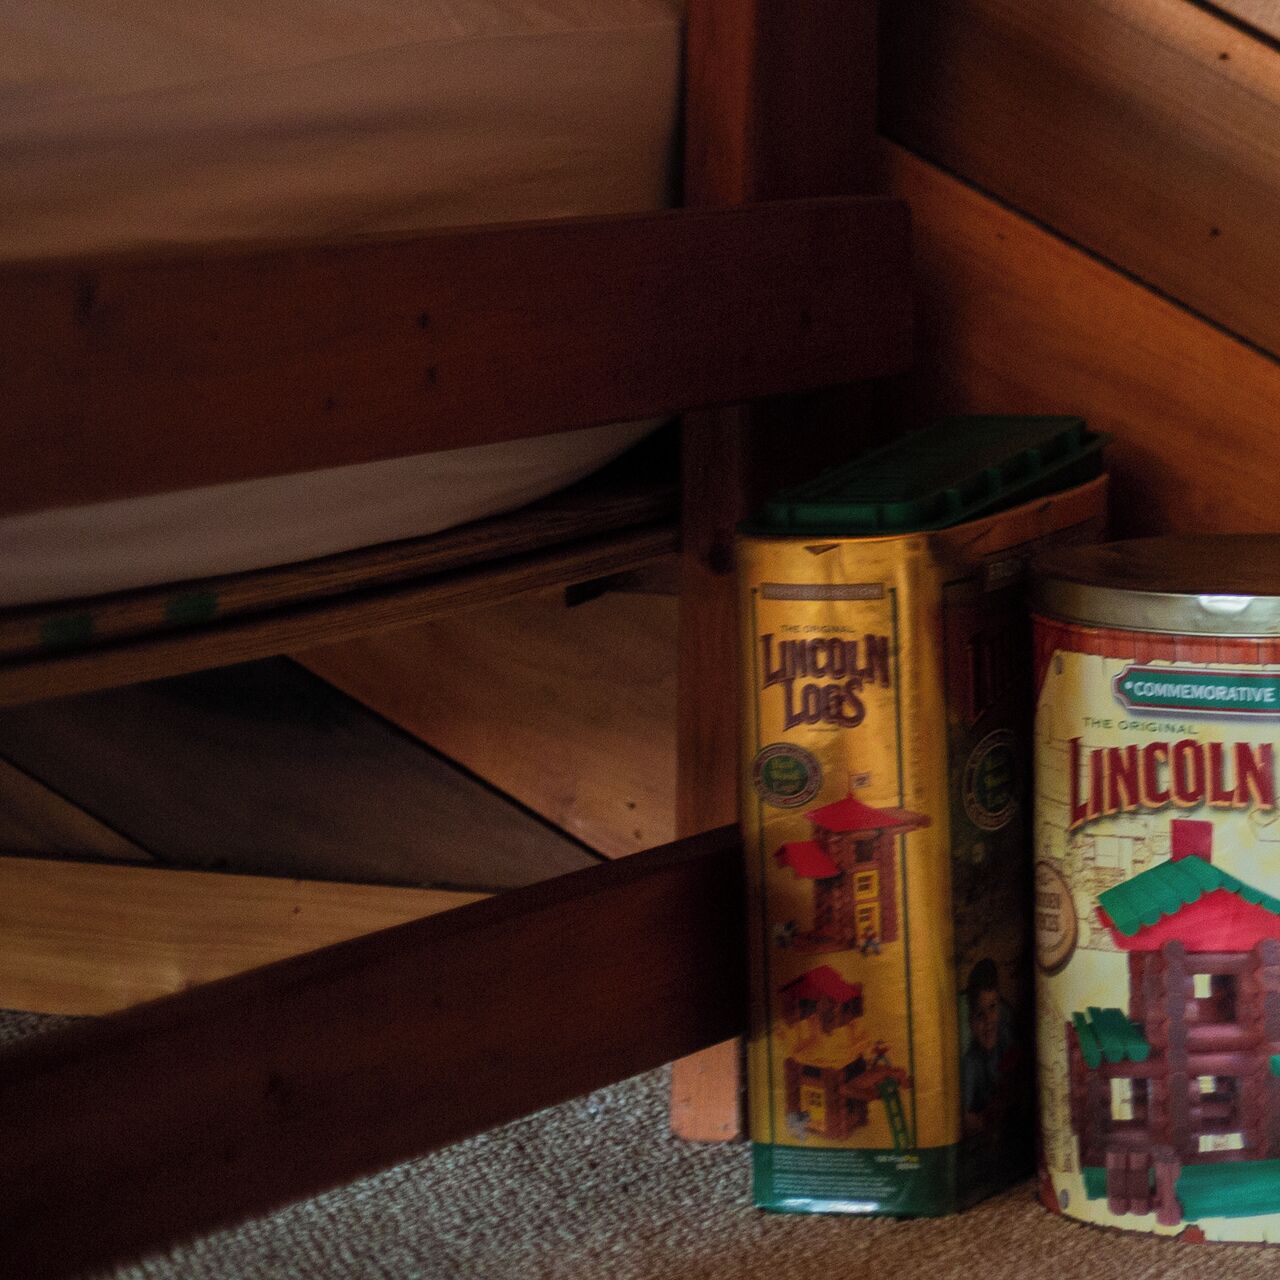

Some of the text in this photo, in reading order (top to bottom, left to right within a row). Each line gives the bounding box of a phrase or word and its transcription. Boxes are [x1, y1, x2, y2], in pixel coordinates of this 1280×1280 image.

[761, 633, 890, 690] LINCOLN
[784, 678, 866, 733] LOGS
[1134, 681, 1277, 703] COMMEMORATIVE
[1083, 716, 1199, 735] THE ORIGINAL
[1070, 735, 1275, 830] LINCOLN
